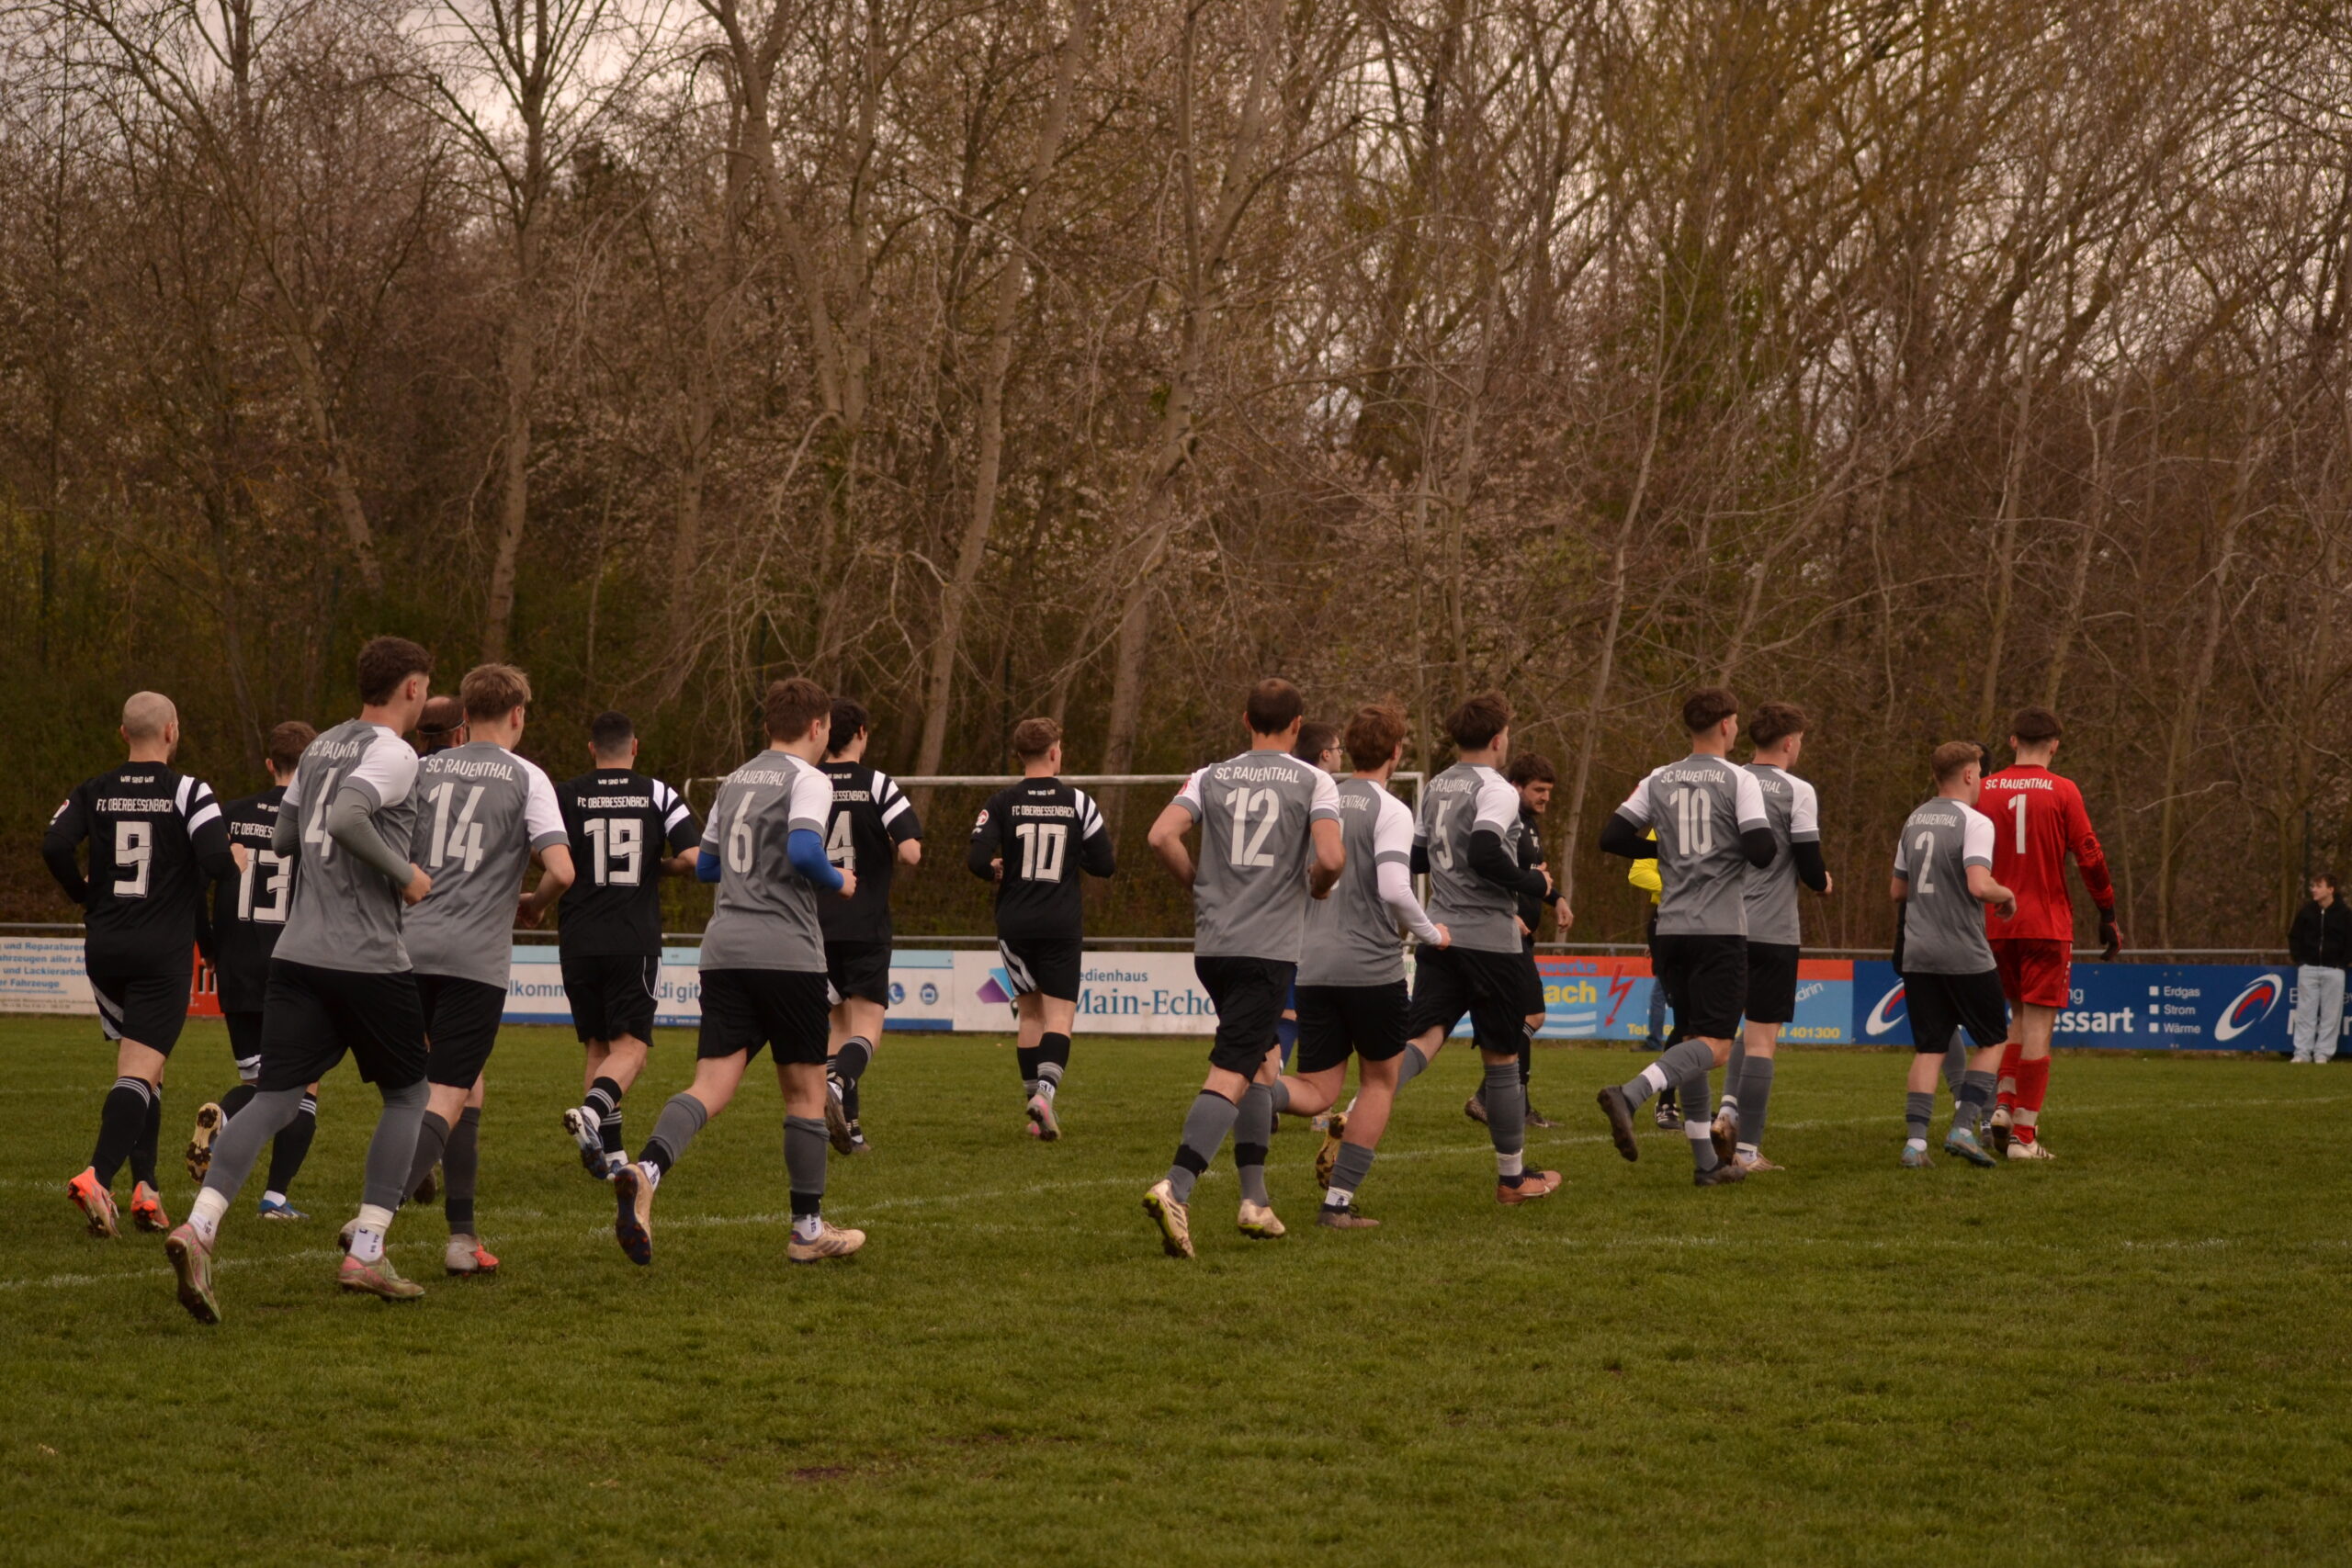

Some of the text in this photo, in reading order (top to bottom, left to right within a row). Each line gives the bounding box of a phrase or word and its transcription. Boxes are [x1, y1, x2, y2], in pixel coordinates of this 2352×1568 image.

[426, 758, 514, 782] SC RAUENTHAL
[735, 770, 786, 786] RAUENTHAL
[1215, 767, 1300, 784] SC RAUENTHAL
[1661, 770, 1725, 784] SC RAUENTHAL
[1985, 778, 2053, 790] SC RAUENTHAL
[577, 796, 650, 808] FC OBERBESSENBACH
[831, 790, 870, 802] BESSENBACH
[96, 797, 174, 813] FC OBERBESSENBACH
[305, 767, 339, 857] 4
[1012, 806, 1075, 818] FC OBERBESSENBACH
[231, 821, 242, 835] FC
[427, 782, 486, 873] 14
[1226, 787, 1280, 867] 12
[1669, 788, 1712, 856] 10
[1915, 814, 1958, 828] RAUENTHAL
[2007, 794, 2027, 855] 1
[728, 791, 756, 874] 6
[1435, 799, 1453, 871] 5
[113, 820, 153, 898] 9
[583, 818, 643, 886] 19
[1015, 822, 1069, 884] 10
[1914, 830, 1935, 894] 2
[237, 847, 294, 925] 13
[0, 955, 47, 964] ahrzeugen
[24, 967, 86, 976] Lackierarbei
[1080, 969, 1148, 983] edienhaus
[10, 978, 61, 989] Fahrzeuge
[2164, 986, 2201, 999] Erdgas
[2164, 1004, 2197, 1016] Strom
[1627, 1023, 1650, 1036] Tel.
[1790, 1026, 1841, 1039] 401300
[2164, 1022, 2201, 1034] Wärme
